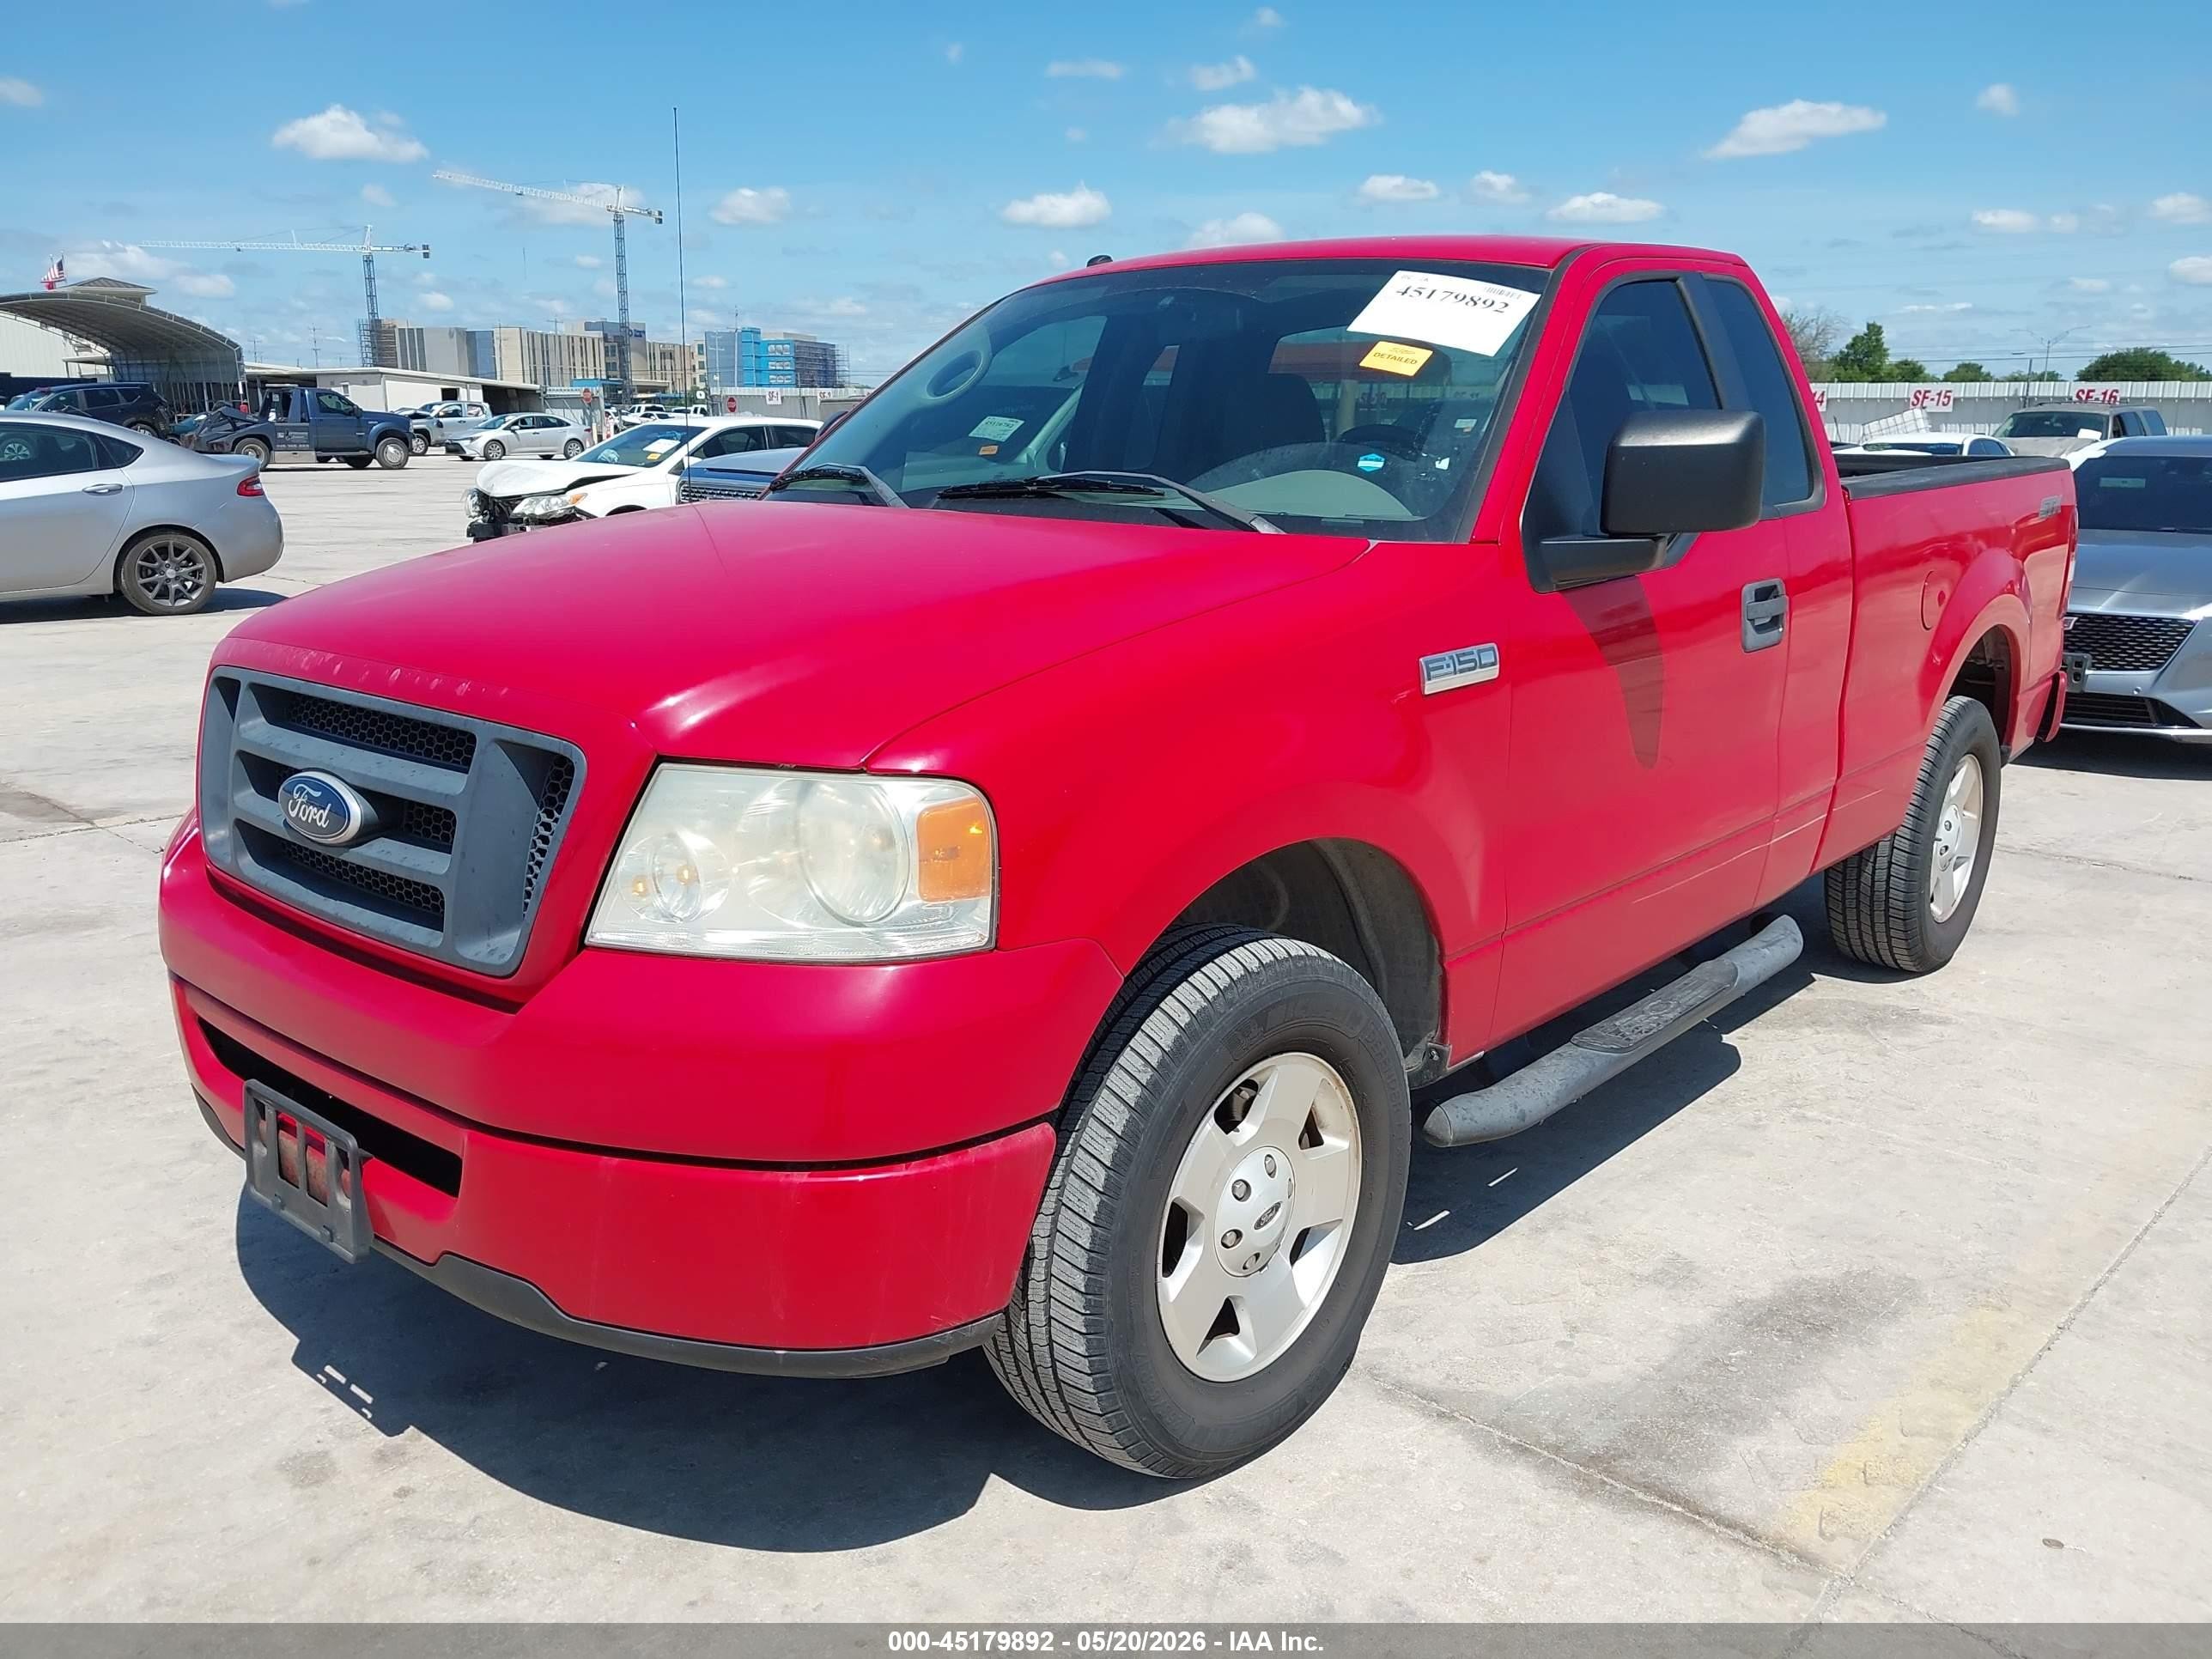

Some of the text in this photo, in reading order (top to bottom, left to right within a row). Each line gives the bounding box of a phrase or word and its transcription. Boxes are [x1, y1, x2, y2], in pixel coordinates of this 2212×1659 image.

[1396, 285, 1509, 313] 45179892
[1373, 352, 1418, 365] DETAILED
[1911, 389, 1953, 407] SF-15
[1424, 645, 1498, 681] F-150
[288, 783, 331, 828] Ford
